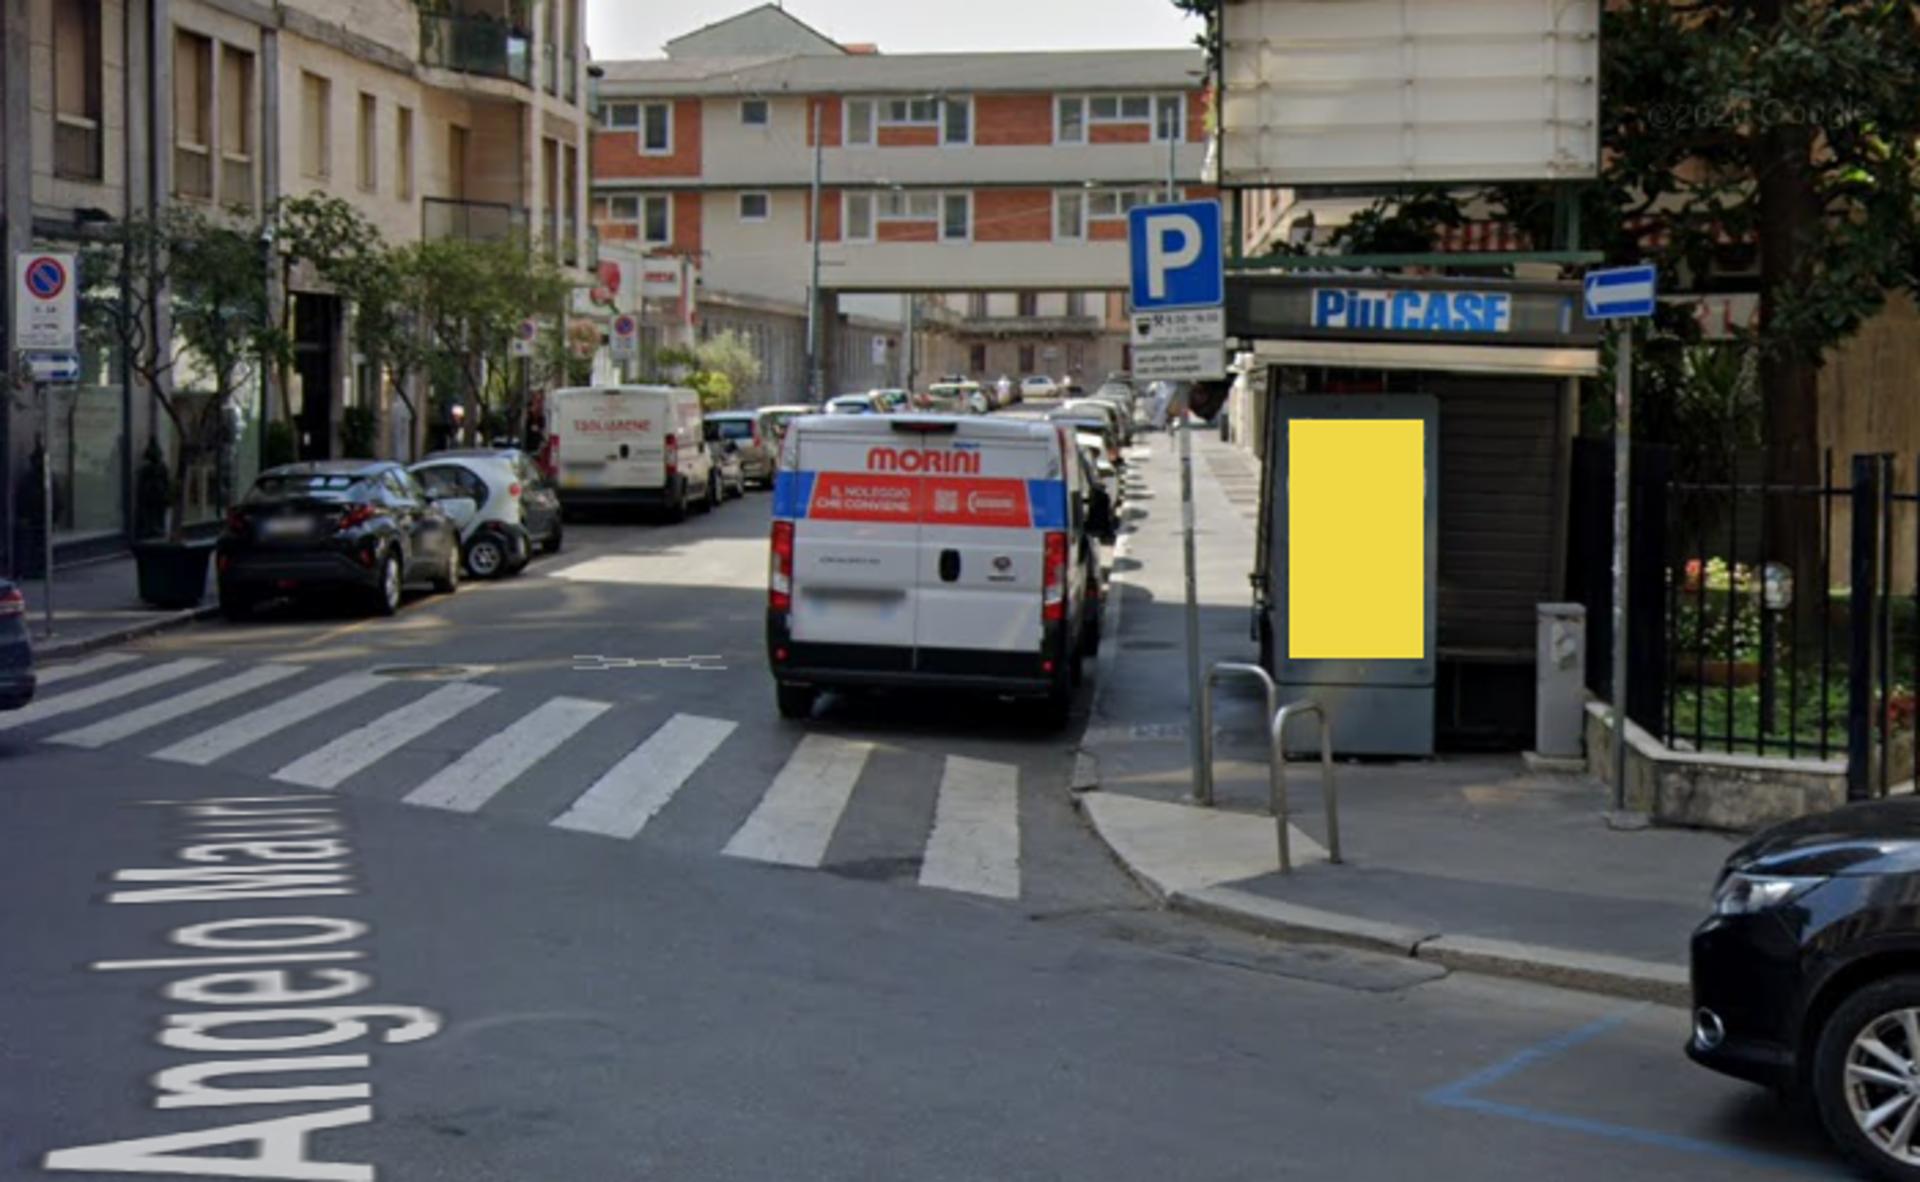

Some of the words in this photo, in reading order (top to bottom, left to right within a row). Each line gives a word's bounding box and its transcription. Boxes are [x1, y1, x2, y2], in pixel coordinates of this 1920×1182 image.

[1146, 213, 1202, 298] P
[867, 448, 981, 474] MORINI
[844, 486, 912, 499] NOLEGGIO
